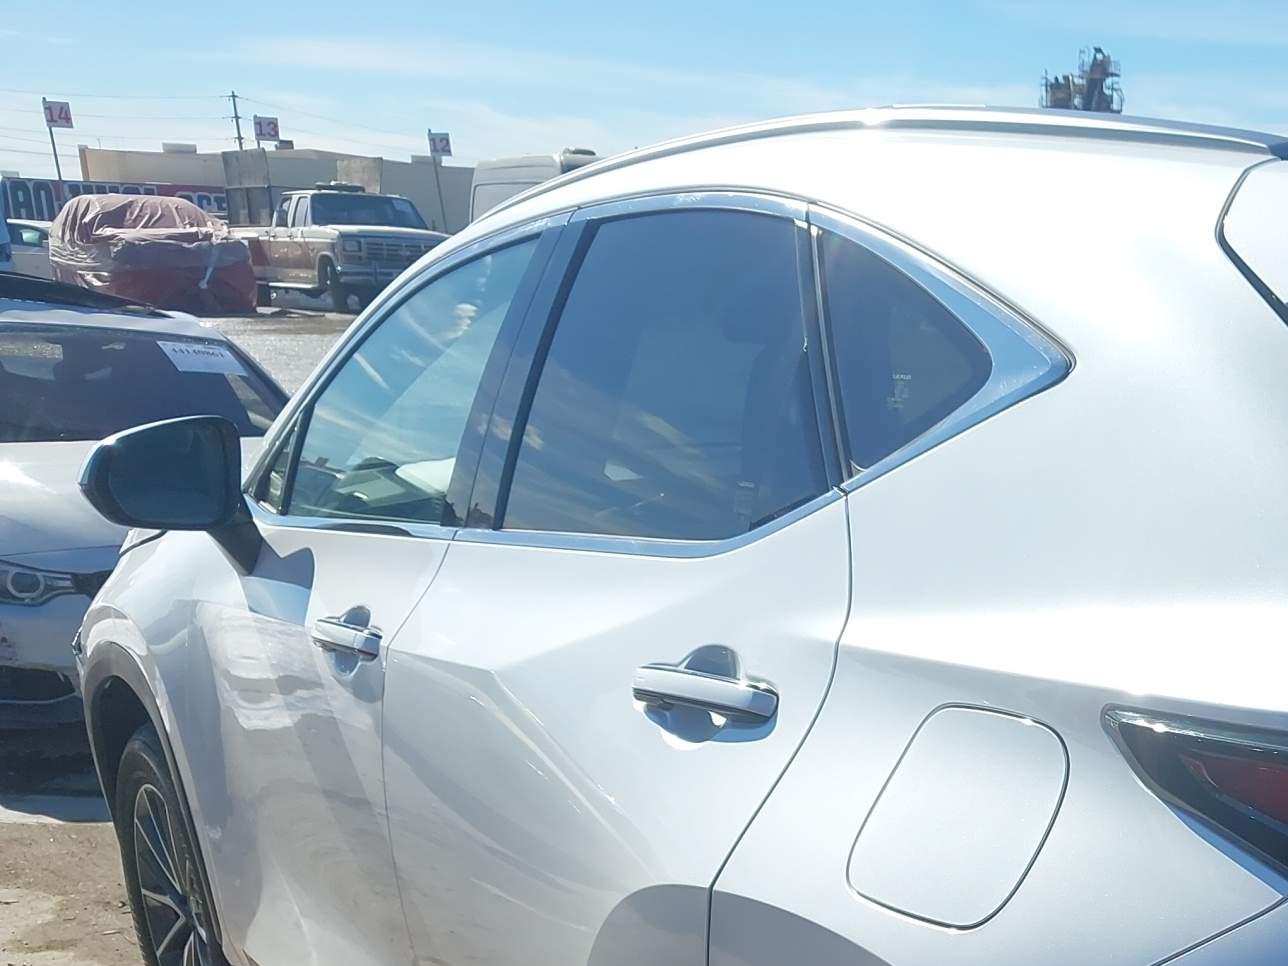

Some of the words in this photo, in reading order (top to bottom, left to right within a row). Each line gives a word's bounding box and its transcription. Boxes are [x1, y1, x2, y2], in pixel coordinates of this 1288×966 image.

[44, 106, 71, 124] 14
[255, 121, 279, 138] 13
[431, 137, 451, 154] 12
